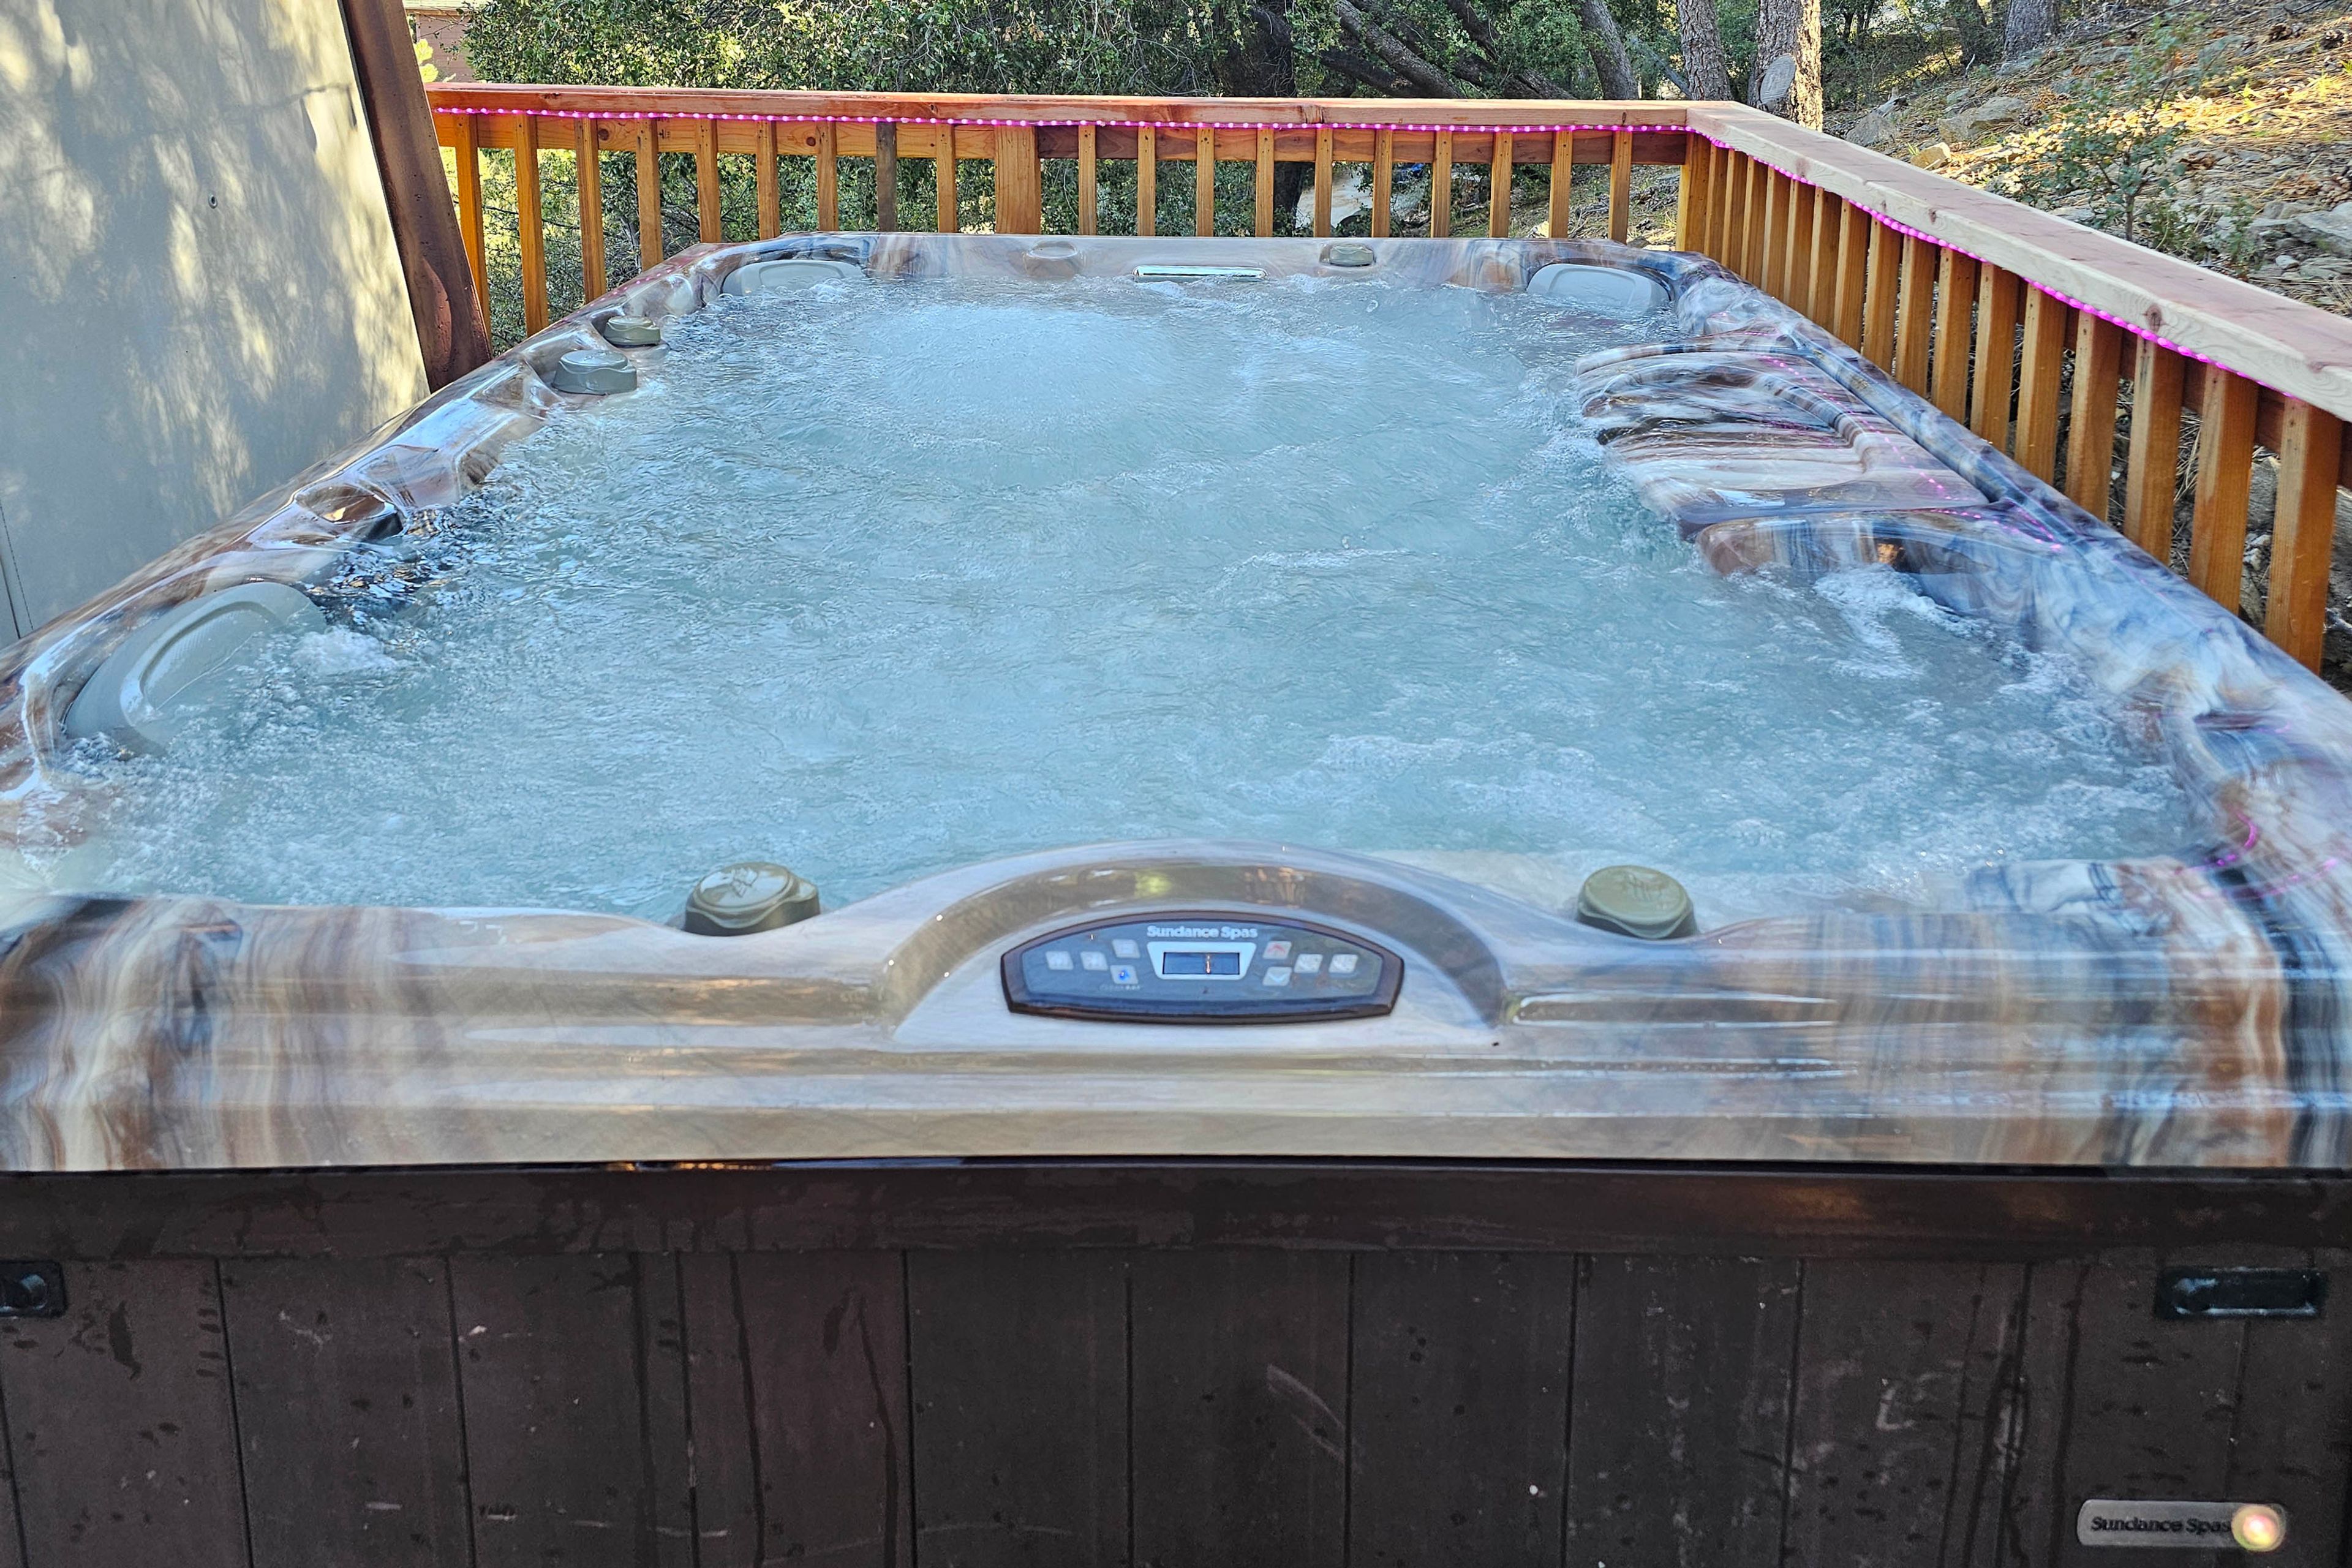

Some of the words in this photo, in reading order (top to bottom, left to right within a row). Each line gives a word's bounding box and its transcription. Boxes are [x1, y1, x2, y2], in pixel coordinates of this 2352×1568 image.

[1147, 925, 1219, 938] Sundance
[1221, 926, 1257, 940] Spas
[2090, 1516, 2182, 1532] Sundance
[2186, 1517, 2231, 1535] Spas
